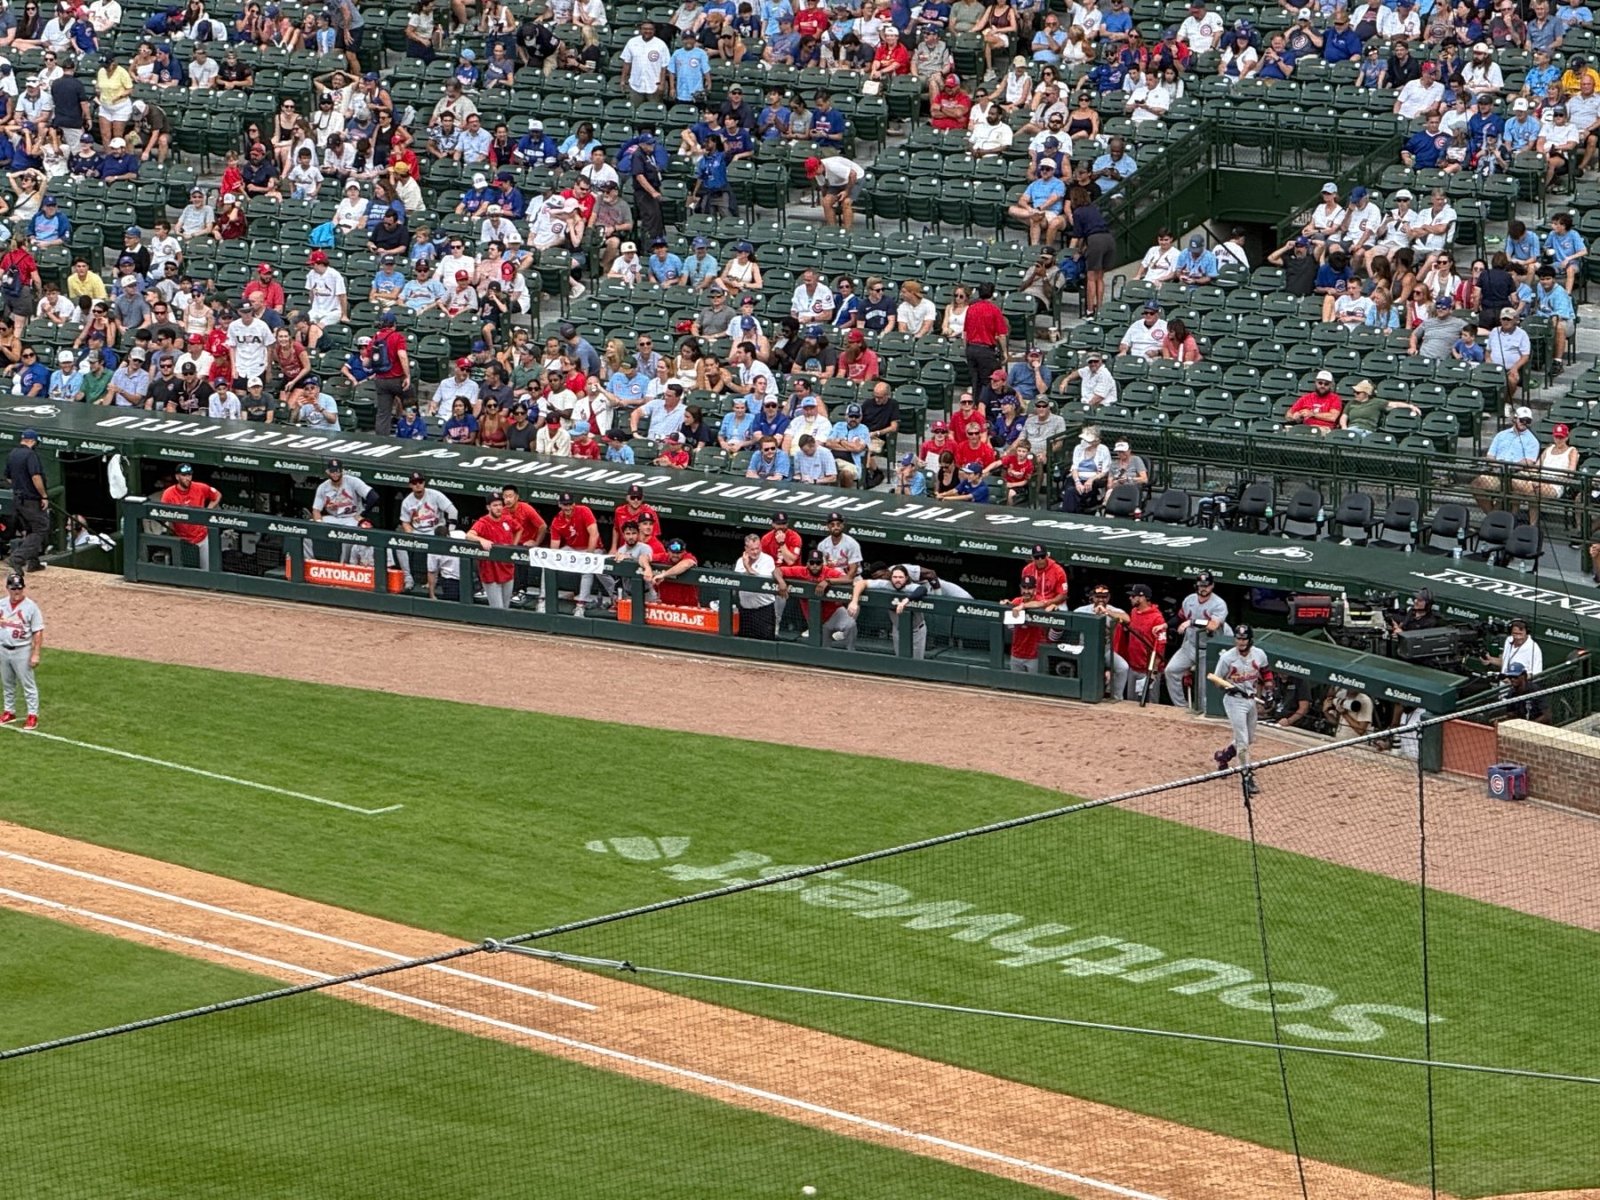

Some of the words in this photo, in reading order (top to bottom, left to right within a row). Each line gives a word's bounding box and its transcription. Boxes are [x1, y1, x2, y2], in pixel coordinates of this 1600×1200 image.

[96, 416, 221, 436] FIELD
[214, 428, 402, 457] WRIGLEY
[399, 448, 460, 458] of
[458, 456, 672, 486] CONFINES
[667, 480, 884, 512] FRIENDLY
[882, 504, 974, 522] THE
[985, 514, 1030, 524] to
[1032, 520, 1208, 547] Welcome
[310, 566, 372, 584] GATORADE
[1298, 608, 1330, 618] ESPN
[12, 630, 26, 639] 82
[665, 851, 1443, 1044] Southwest
